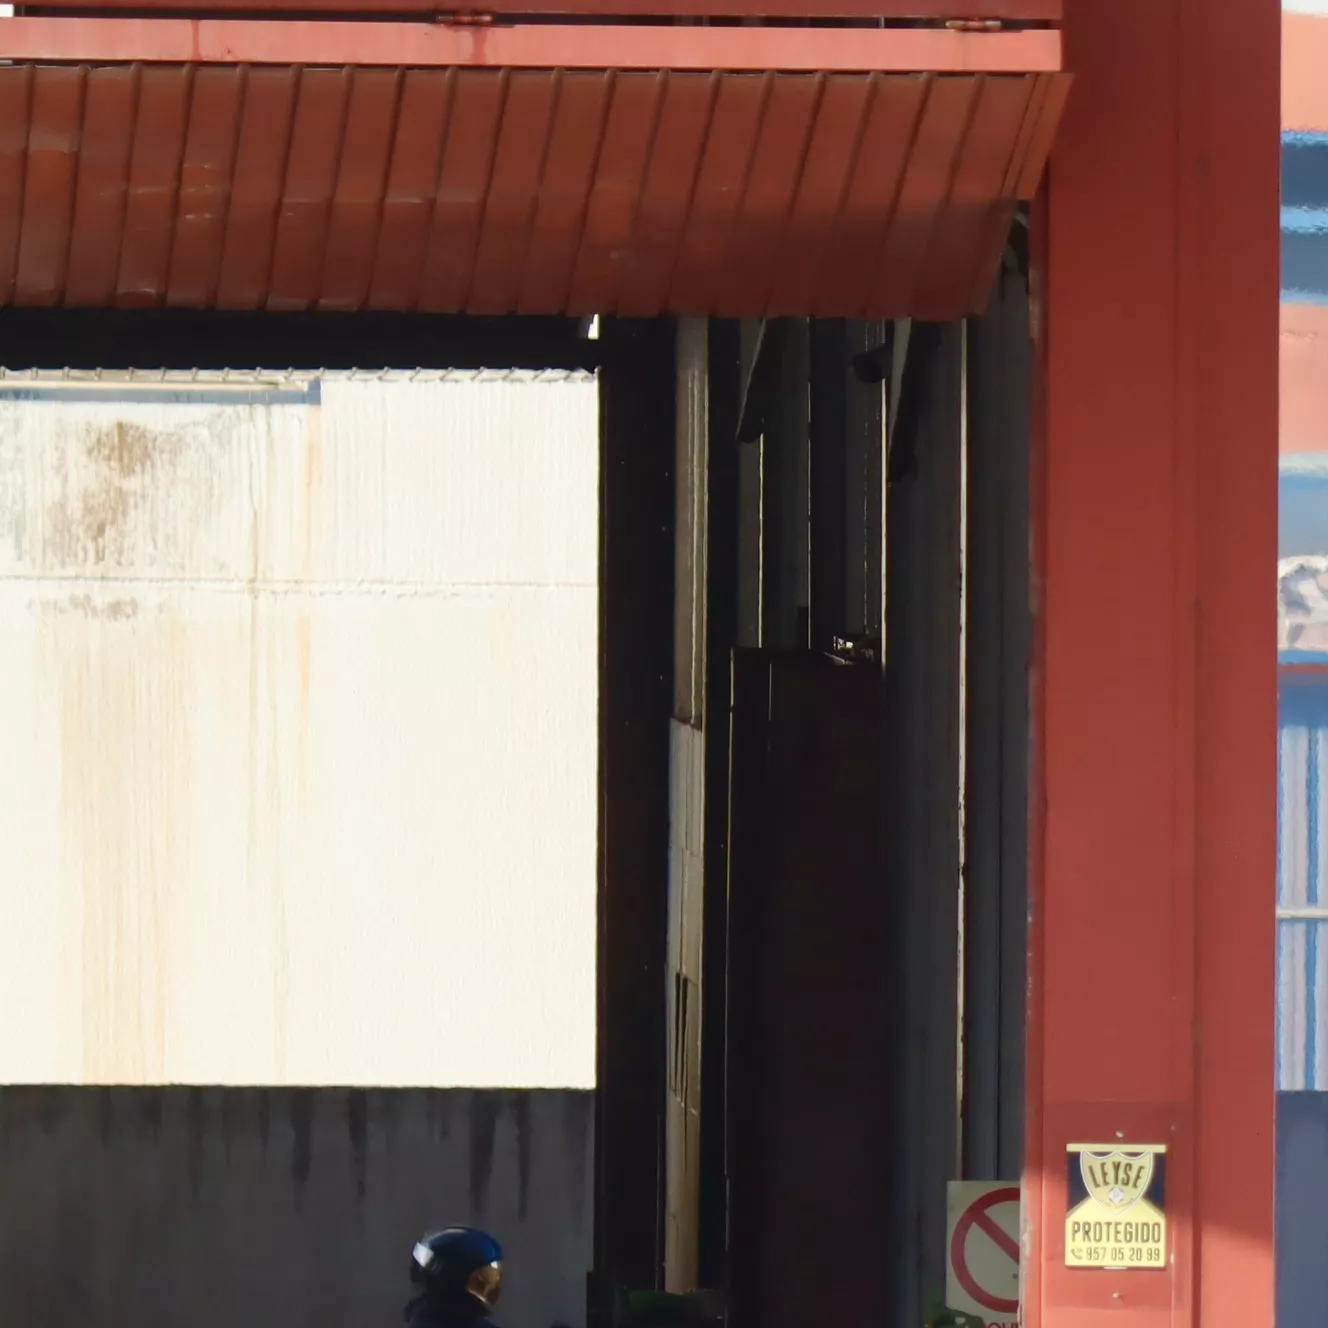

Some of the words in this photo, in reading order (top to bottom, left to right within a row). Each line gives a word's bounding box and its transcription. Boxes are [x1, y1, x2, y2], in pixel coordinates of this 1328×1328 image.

[1088, 1161, 1145, 1189] LEYSE
[1071, 1221, 1162, 1243] PROTEGIDO
[1086, 1247, 1107, 1261] 957
[1111, 1247, 1125, 1261] 05
[1129, 1247, 1143, 1261] 20
